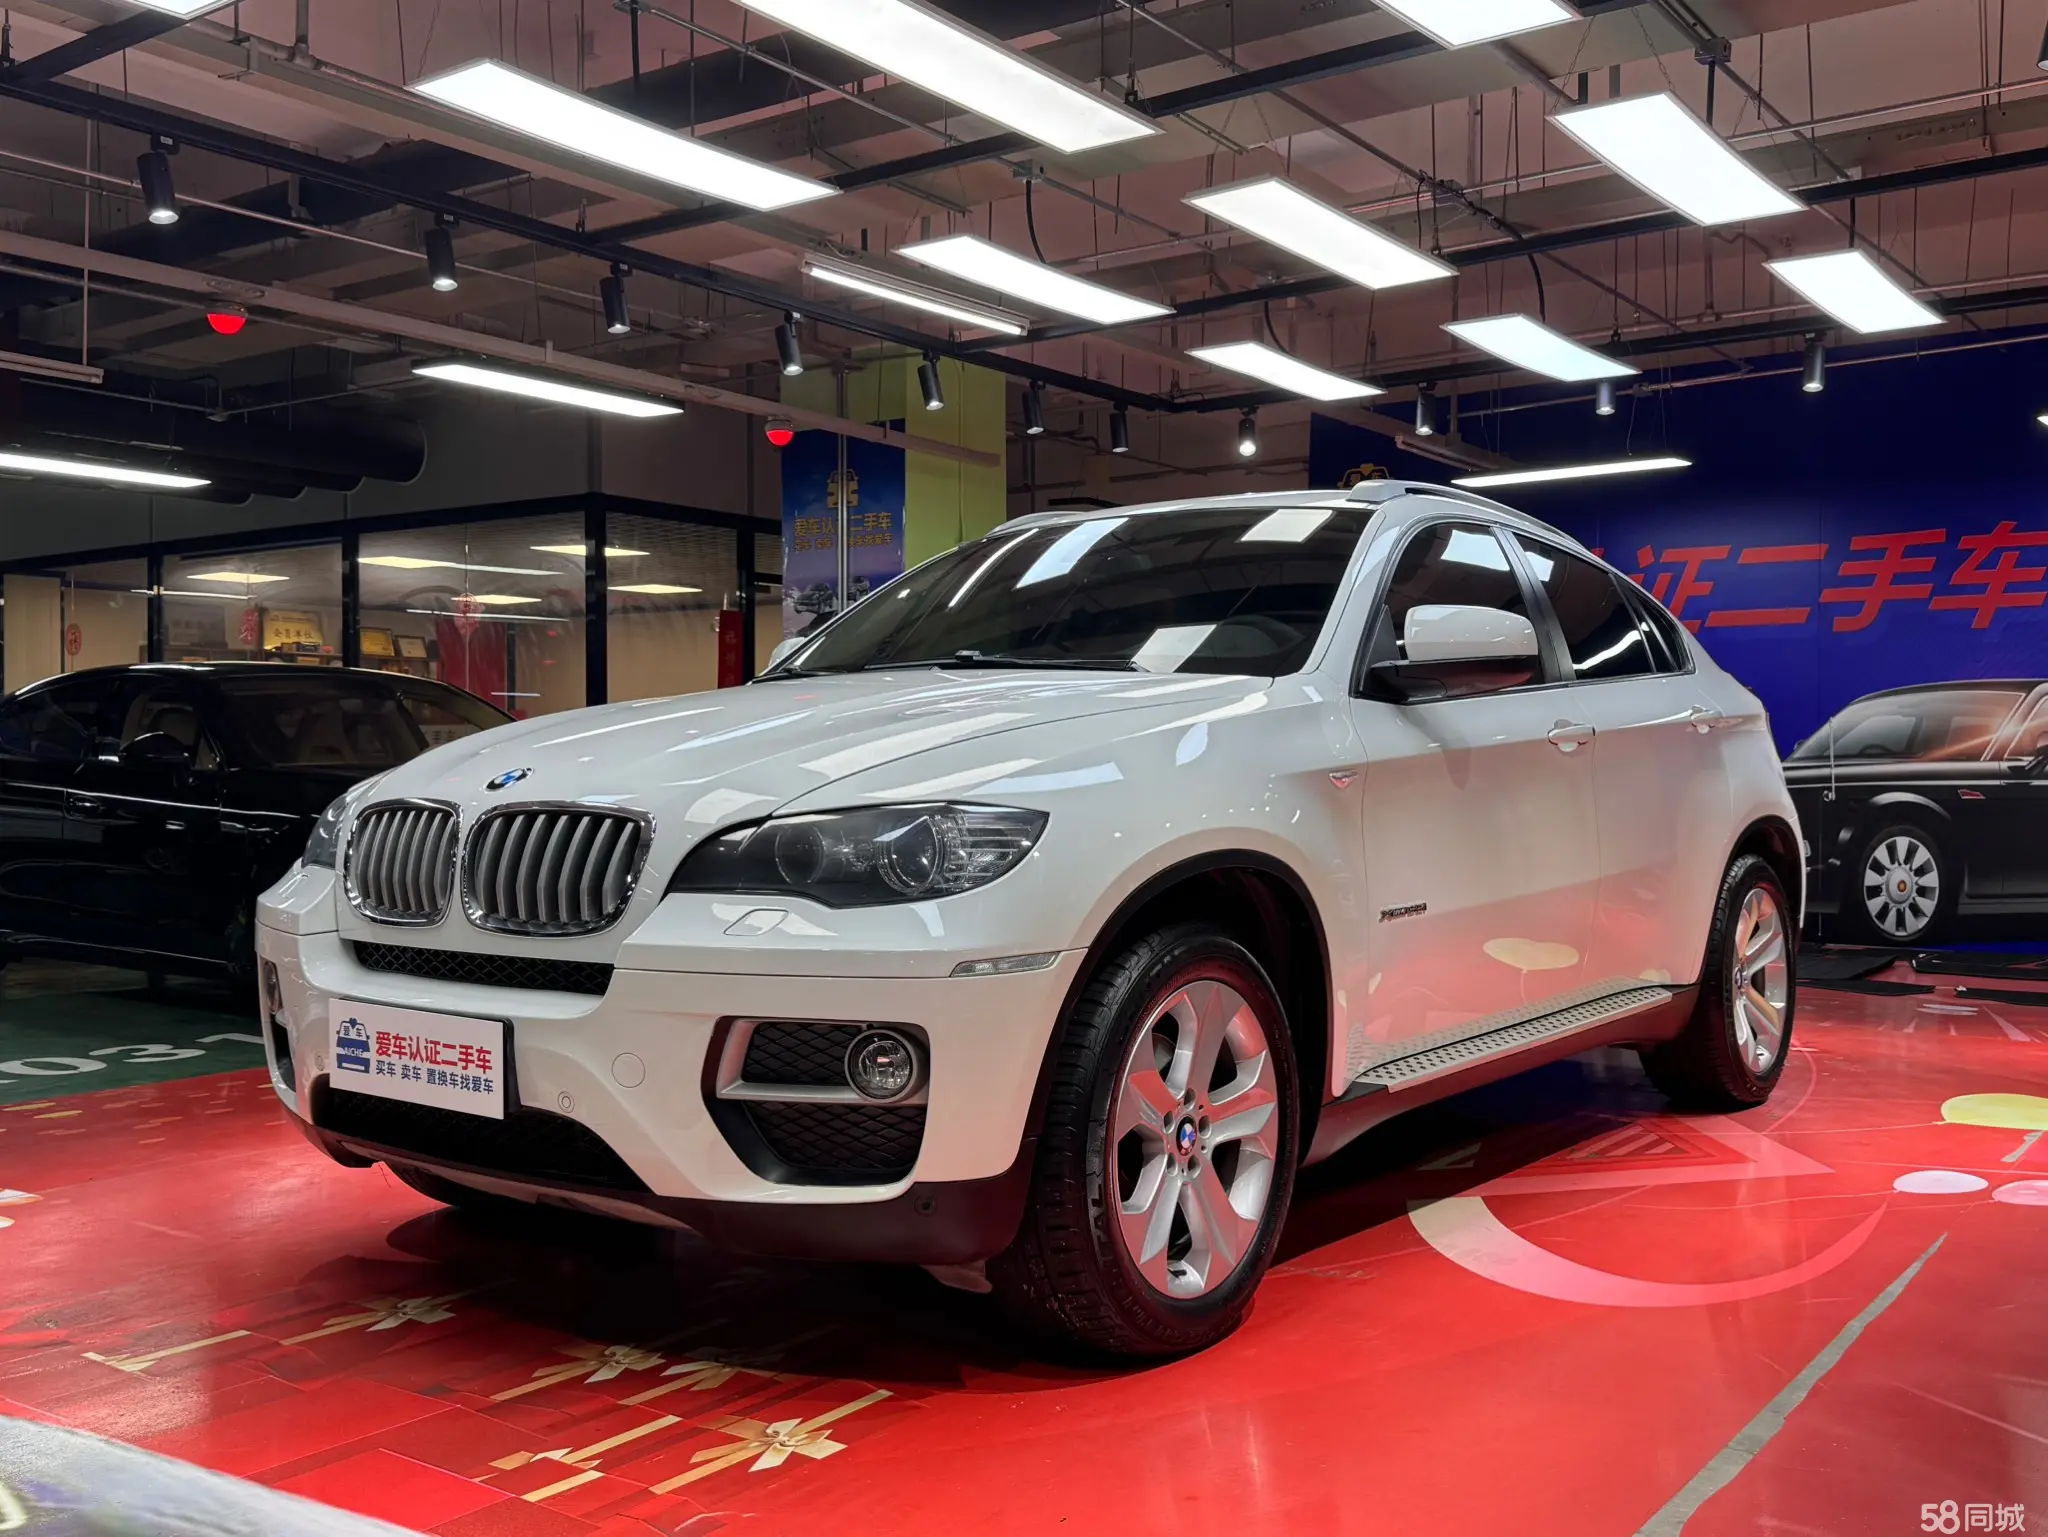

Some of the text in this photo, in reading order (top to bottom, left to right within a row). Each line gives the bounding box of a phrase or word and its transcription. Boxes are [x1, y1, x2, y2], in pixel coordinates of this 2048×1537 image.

[794, 512, 892, 536] 爱车认二手车
[1592, 521, 2048, 634] 证二手车
[344, 1046, 364, 1058] AICHE
[376, 1030, 493, 1075] 爱车认证二手车
[376, 1060, 494, 1095] 买车 卖车 置换车找爱车
